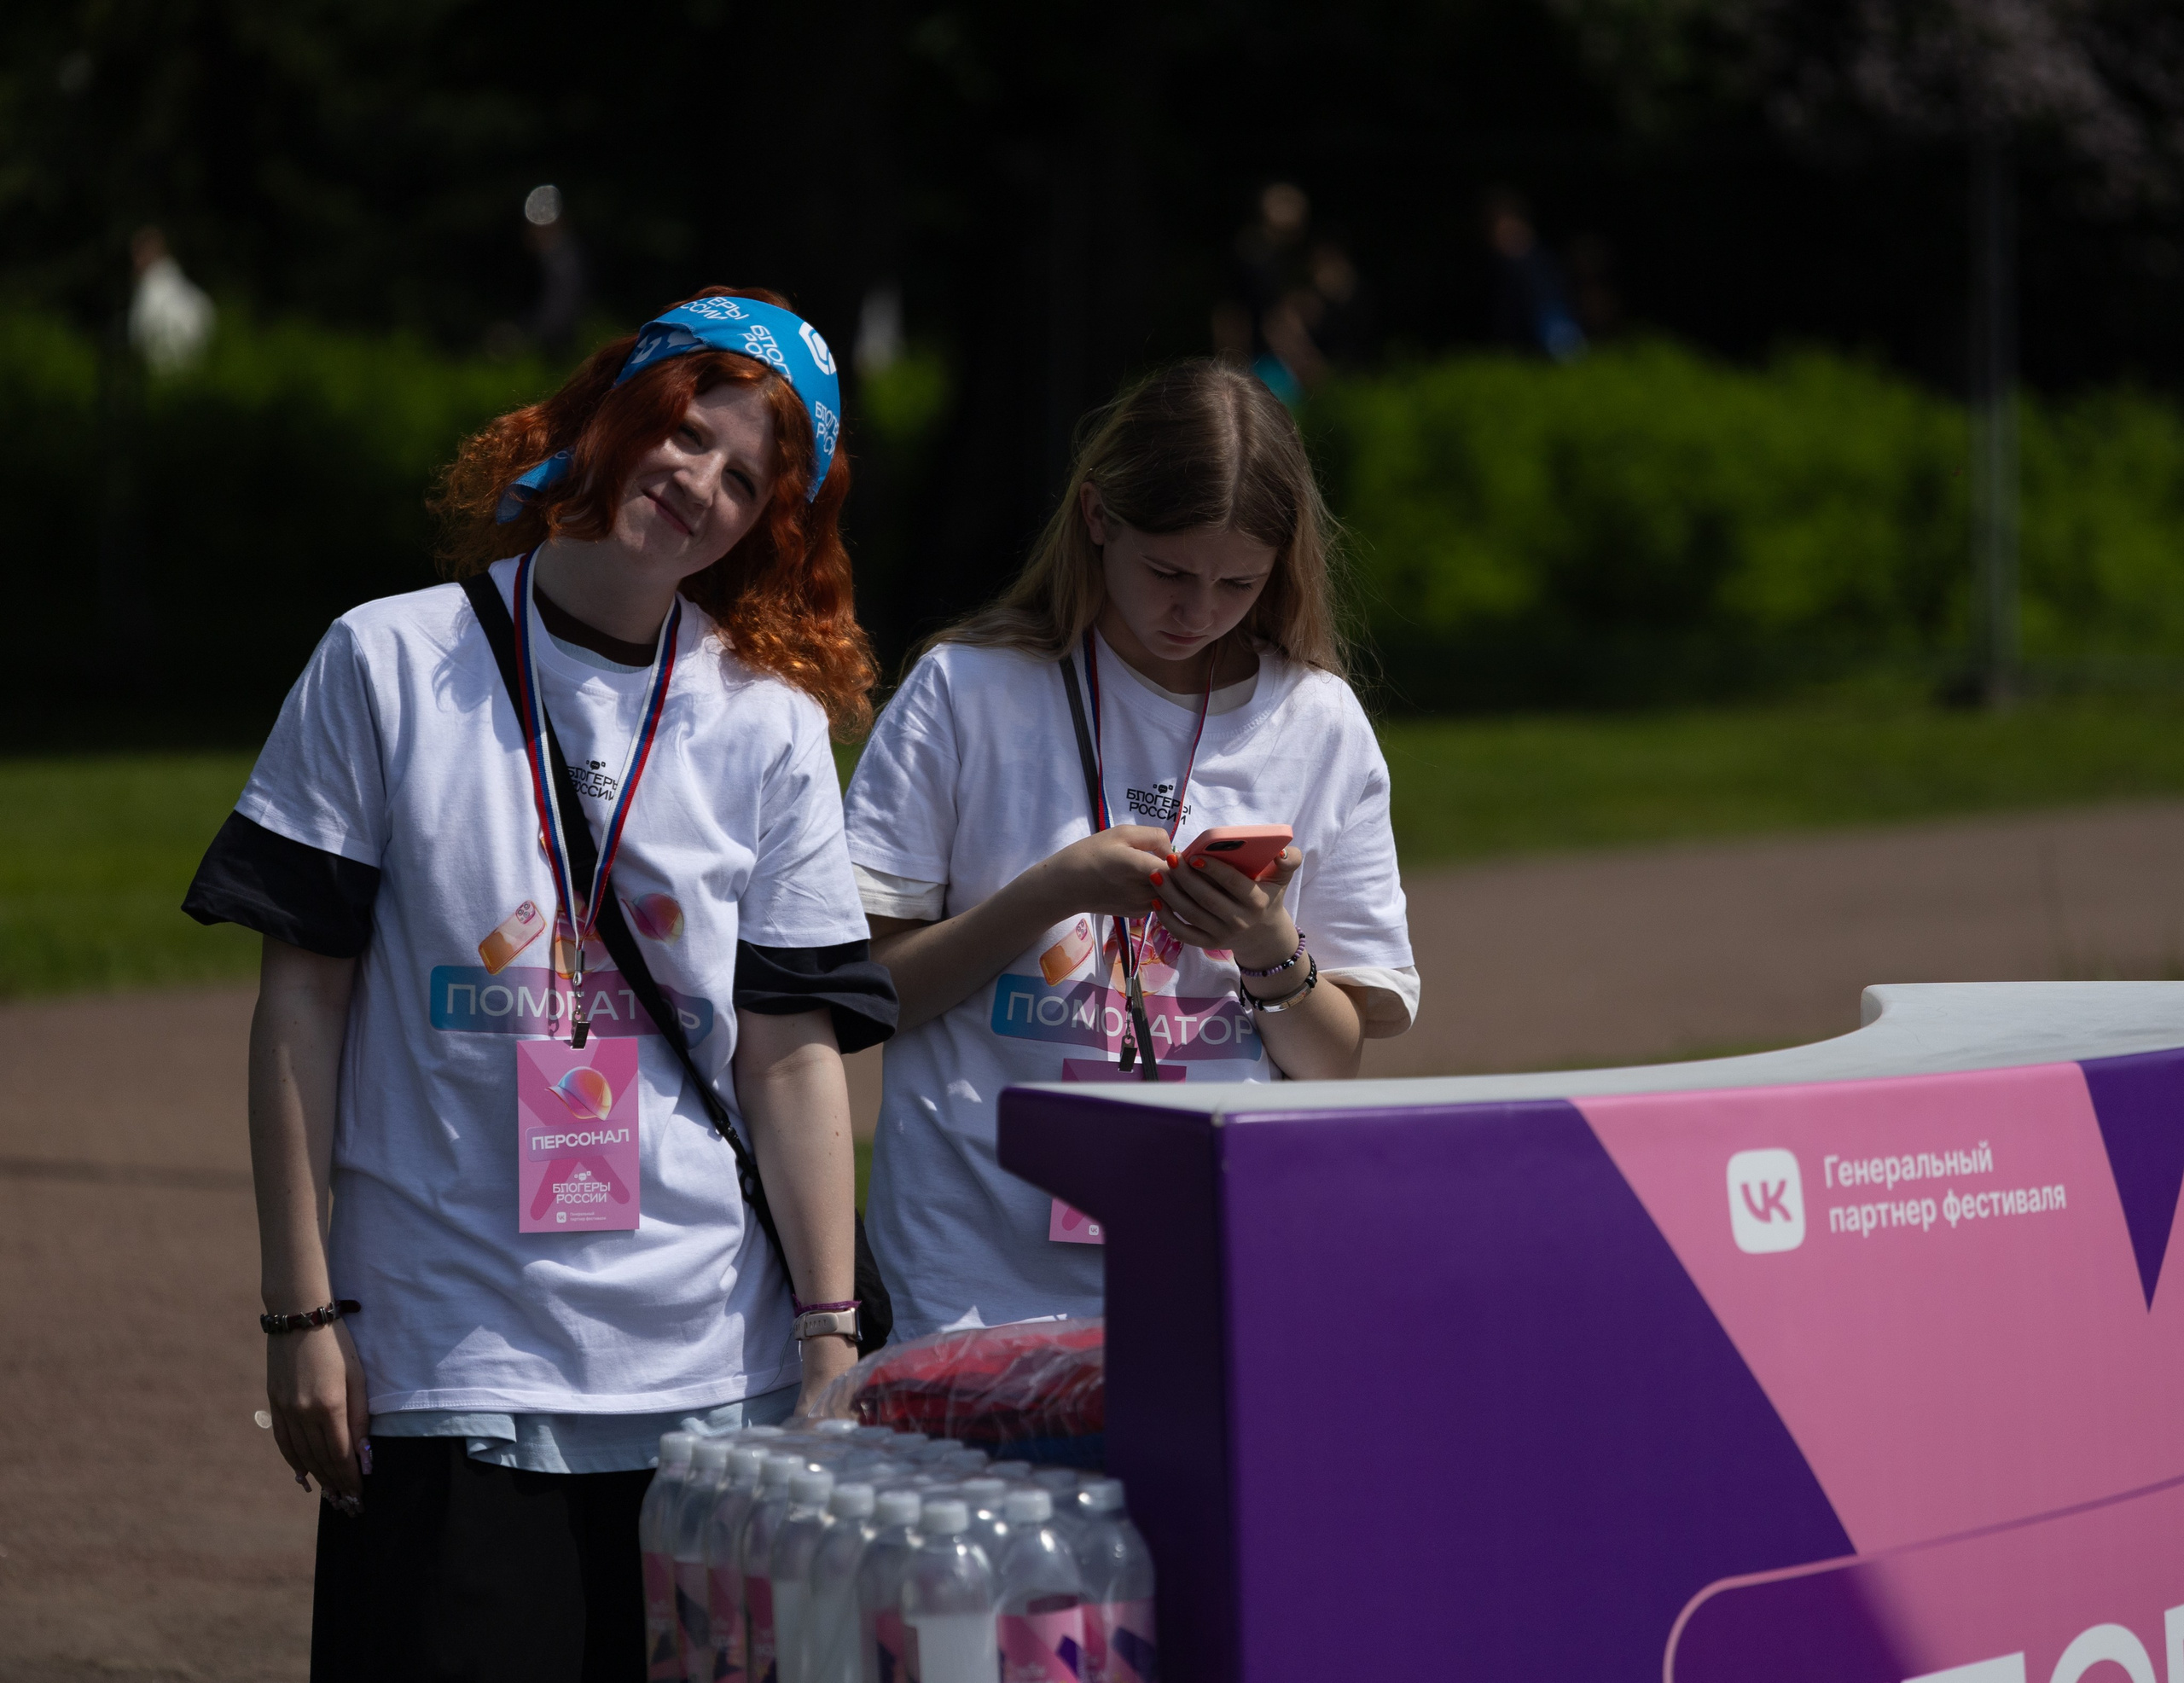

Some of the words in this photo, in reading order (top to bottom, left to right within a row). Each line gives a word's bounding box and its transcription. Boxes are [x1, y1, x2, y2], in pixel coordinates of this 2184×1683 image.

[1006, 991, 1253, 1046] ПОМОАТОР
[531, 1128, 630, 1151] ПЕРСОНАЛ
[1822, 1140, 1994, 1190] Генеральный
[552, 1181, 611, 1193] БЛОГЕРЫ
[556, 1193, 607, 1204] РОССИИ
[1828, 1196, 1937, 1239] партнер
[1942, 1183, 2067, 1228] фестиваля
